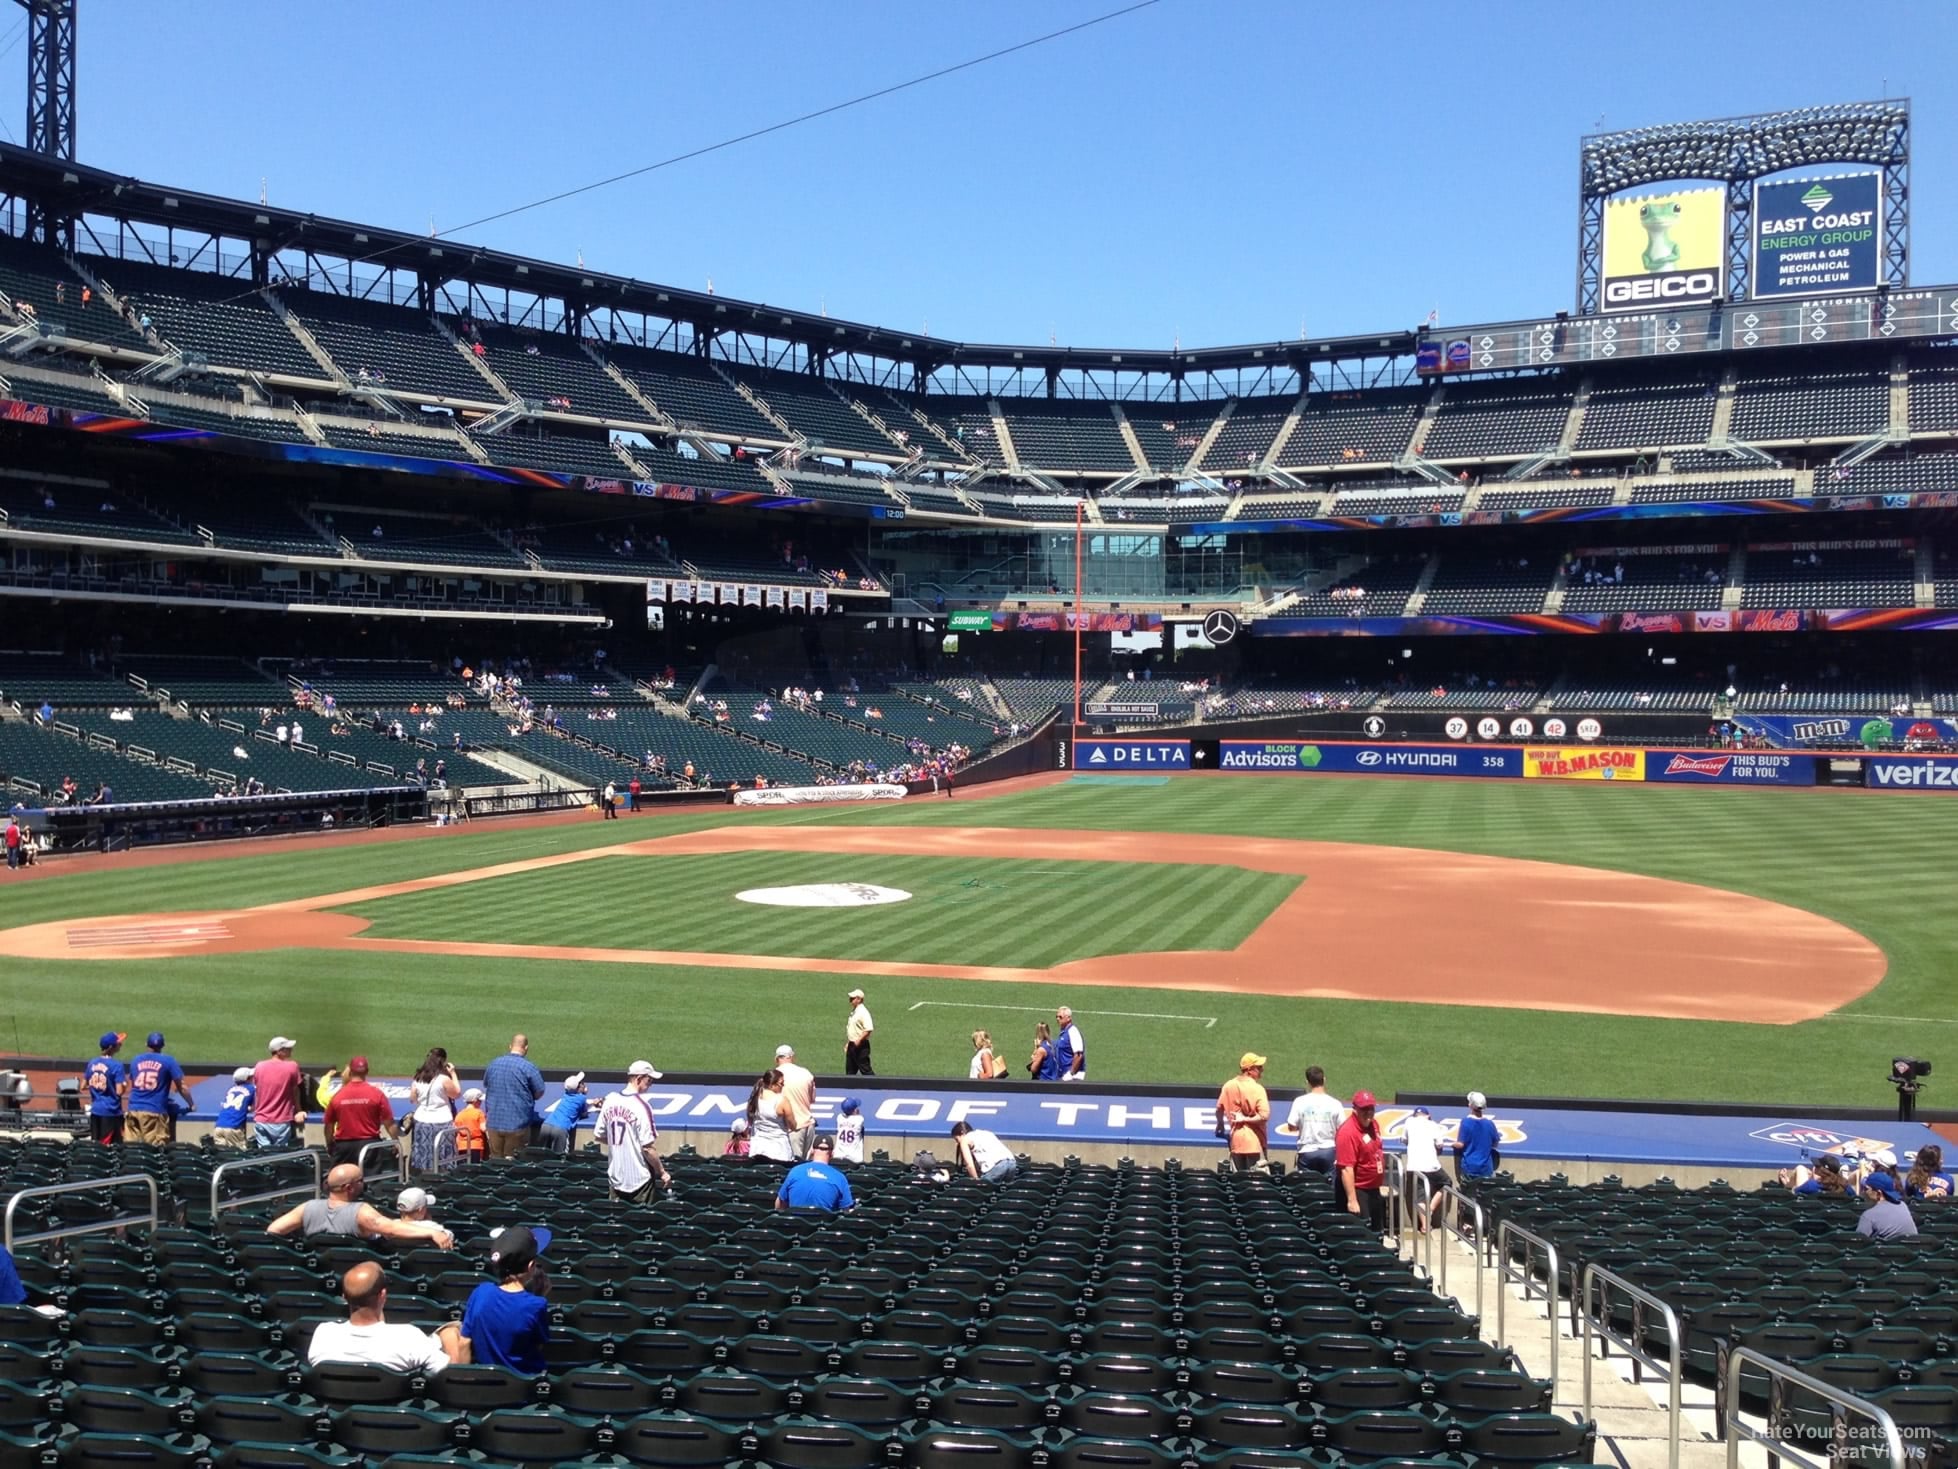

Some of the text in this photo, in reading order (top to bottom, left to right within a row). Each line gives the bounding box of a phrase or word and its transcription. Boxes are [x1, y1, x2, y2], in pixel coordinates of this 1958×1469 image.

[1761, 211, 1873, 235] EAST COAST
[1761, 229, 1873, 250] ENERGY GROUP
[1780, 248, 1850, 262] POWER & GAS
[1779, 260, 1850, 274] MECHANICAL
[1779, 272, 1849, 286] PETROLEUM
[1606, 273, 1714, 302] GEICO
[1802, 296, 1871, 308] NATIONAL
[1607, 314, 1657, 325] LEAGUE
[633, 483, 654, 496] VS
[1883, 496, 1909, 507] VS
[886, 509, 904, 519] 12:00
[951, 616, 989, 625] SUBWAY
[1696, 616, 1727, 629] VS
[1450, 723, 1463, 733] 37
[1483, 723, 1494, 733] 14
[1516, 723, 1527, 734] 41
[1548, 723, 1562, 734] 42
[1579, 725, 1598, 734] SHEA
[1113, 747, 1185, 762] DELTA
[1265, 745, 1296, 753] BLOCK
[1222, 750, 1297, 767] Advisors
[1386, 753, 1457, 767] HYUNDAI
[1482, 756, 1504, 767] 358
[1671, 758, 1724, 770] Budweiser
[1732, 755, 1790, 767] THIS BUD'S
[1732, 767, 1779, 778] FOR YOU.
[134, 1071, 158, 1091] 45
[875, 1098, 1007, 1122] OF
[1040, 1101, 1232, 1131] THE
[611, 1121, 626, 1145] 17
[839, 1130, 855, 1144] 48
[1769, 1130, 1841, 1145] citi
